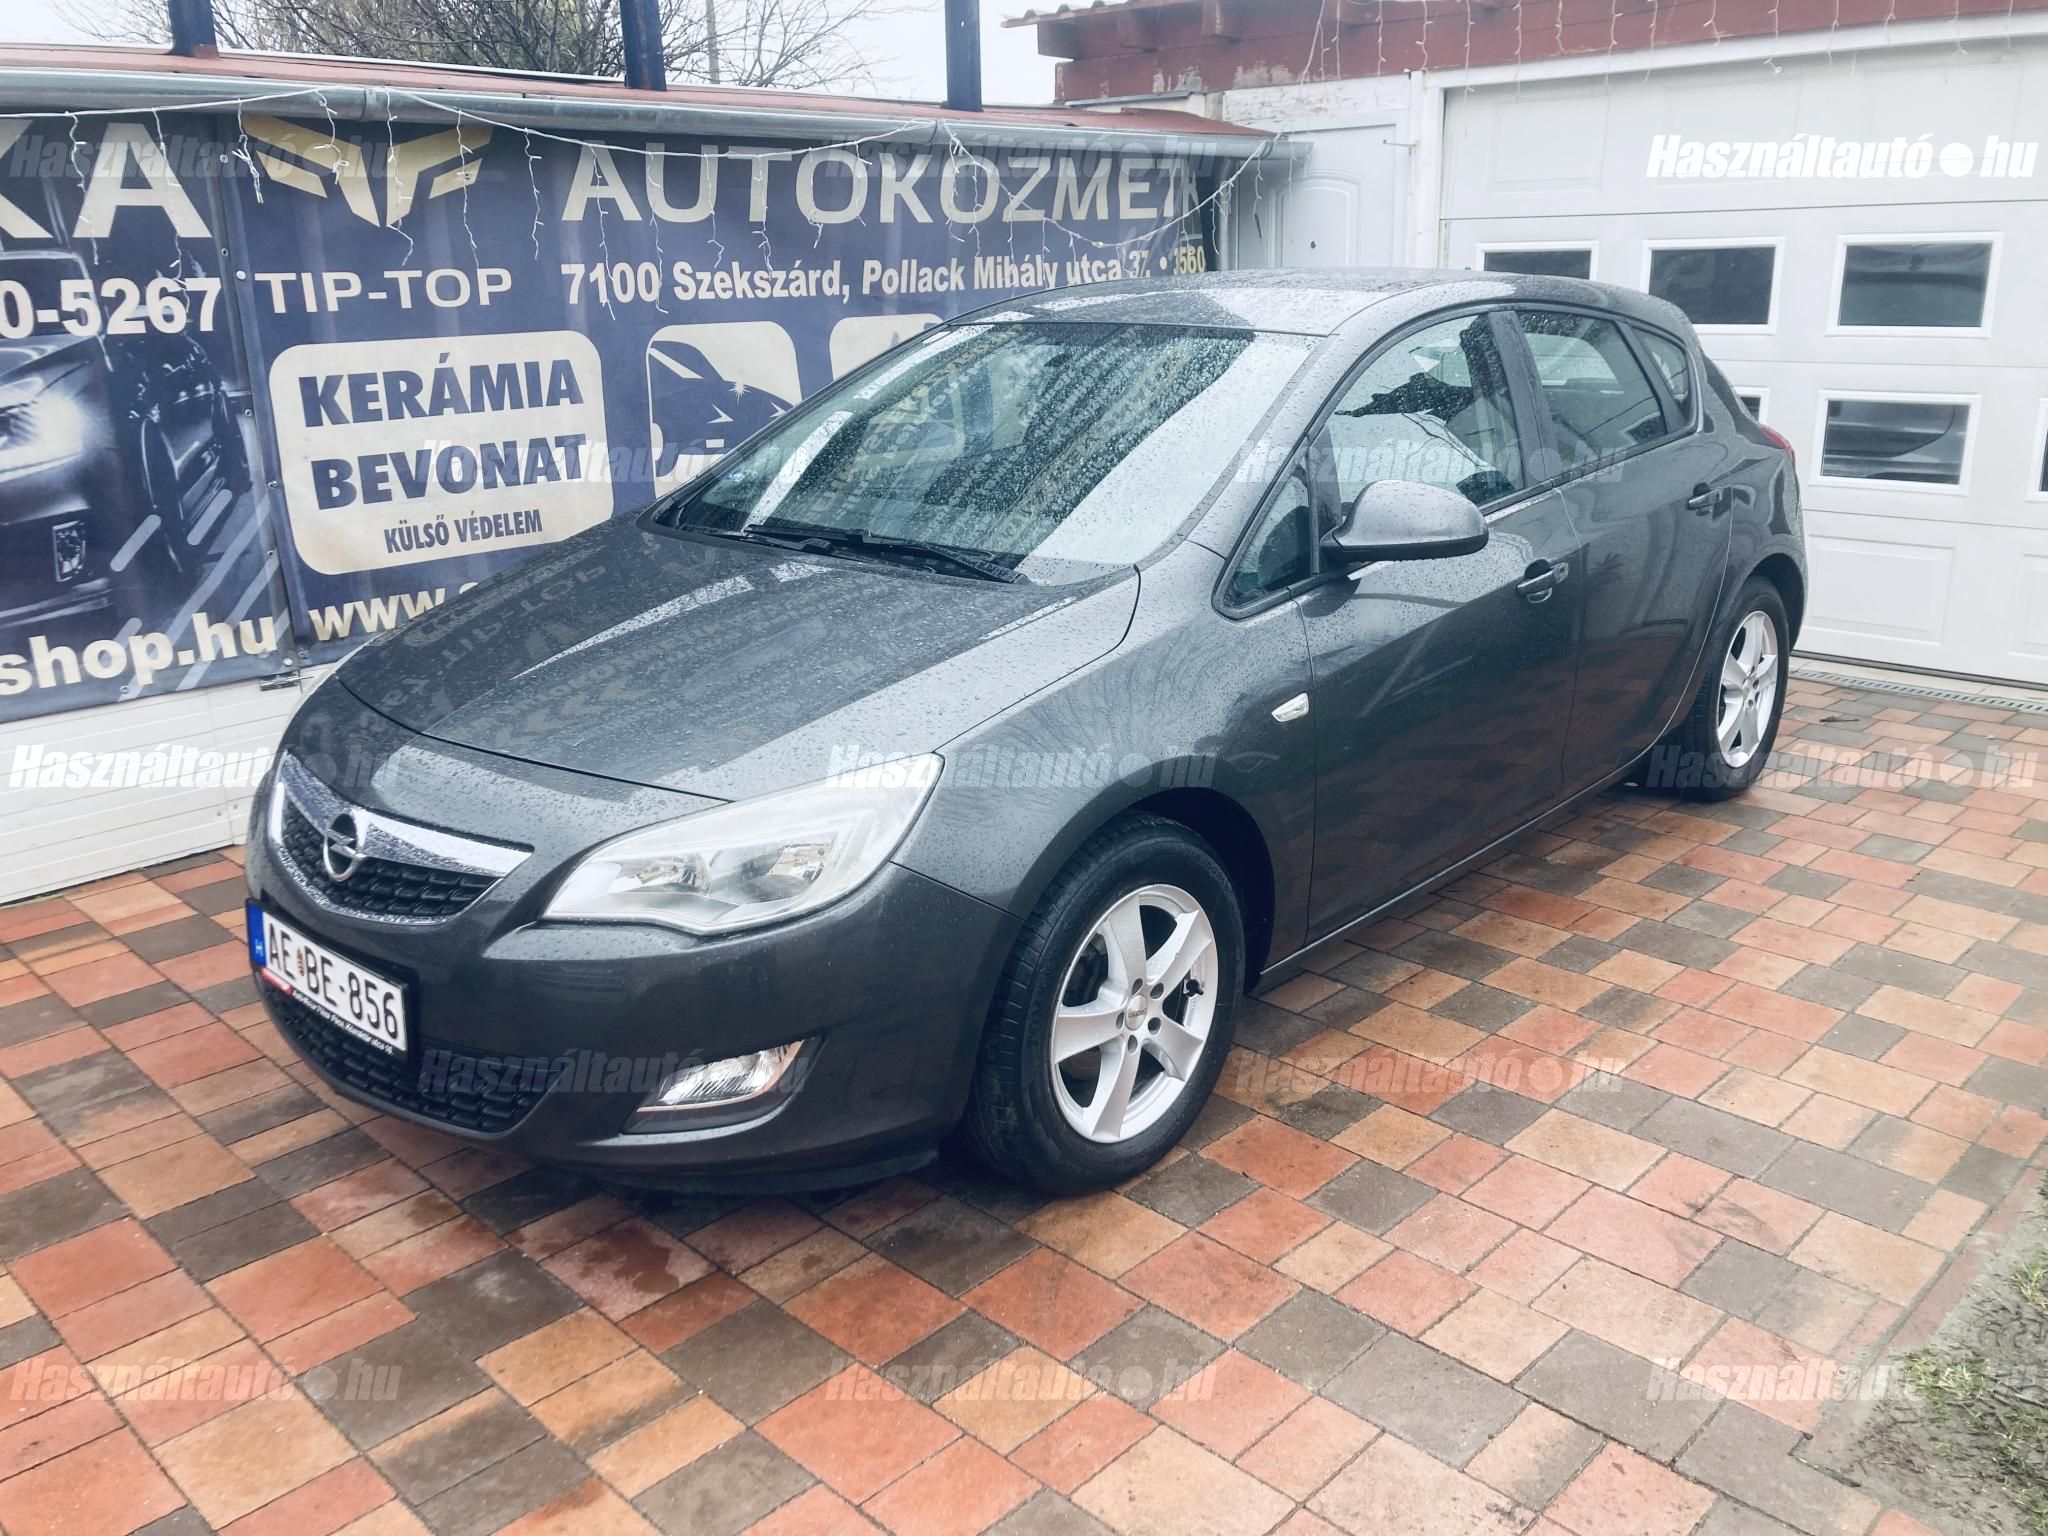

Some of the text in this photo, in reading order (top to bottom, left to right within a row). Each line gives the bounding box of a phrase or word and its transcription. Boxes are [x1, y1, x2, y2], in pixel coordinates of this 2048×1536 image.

[255, 267, 513, 314] TIP-TOP
[561, 263, 659, 304] 7100
[673, 260, 850, 304] Szekszárd,
[862, 257, 965, 295] Pollack
[974, 253, 1058, 290] Mihály
[1066, 254, 1121, 282] utca
[0, 277, 222, 339] 0-5267
[298, 353, 584, 427] KERÁMIA
[311, 433, 586, 510] BEVONAT
[384, 509, 543, 553] KÜLSŐ VÉDELEM
